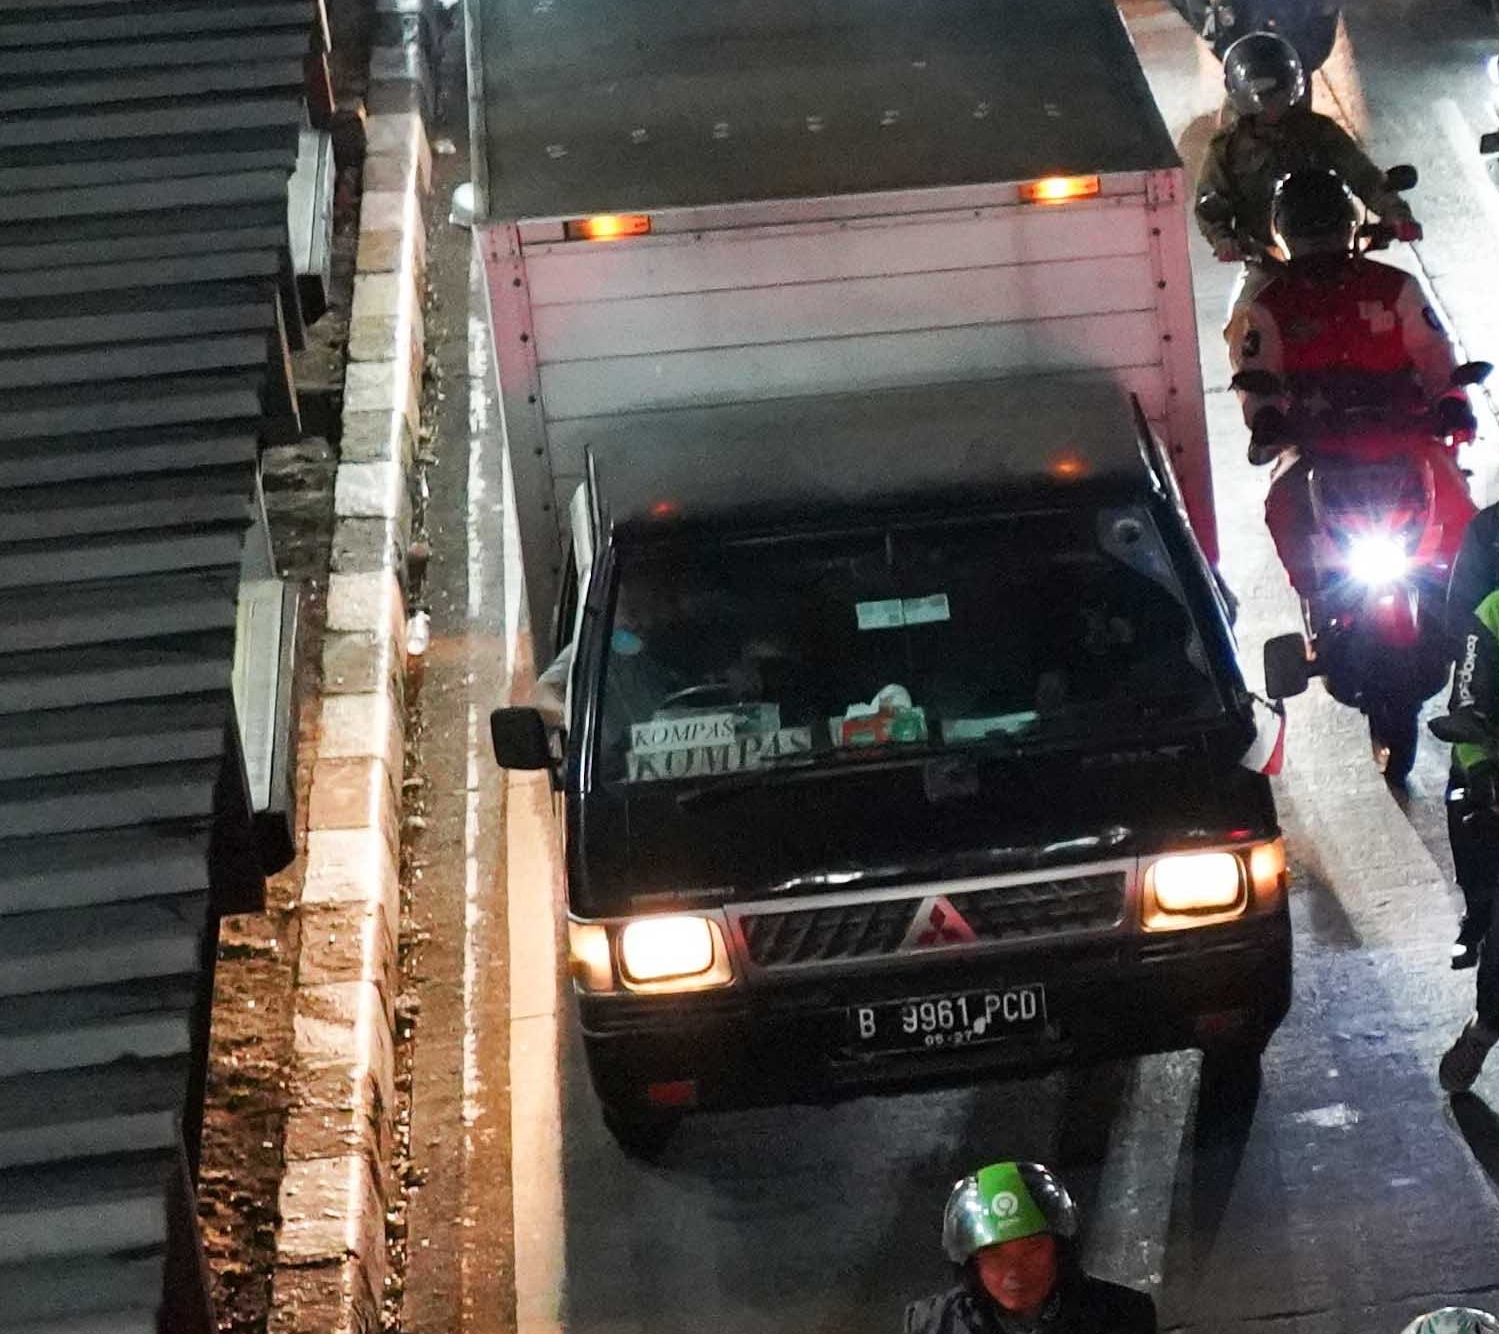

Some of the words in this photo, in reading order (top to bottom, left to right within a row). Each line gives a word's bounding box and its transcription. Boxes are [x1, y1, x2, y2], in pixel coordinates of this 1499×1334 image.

[633, 720, 736, 747] KOMPAS
[858, 1008, 876, 1039] B
[984, 991, 1036, 1025] PCD
